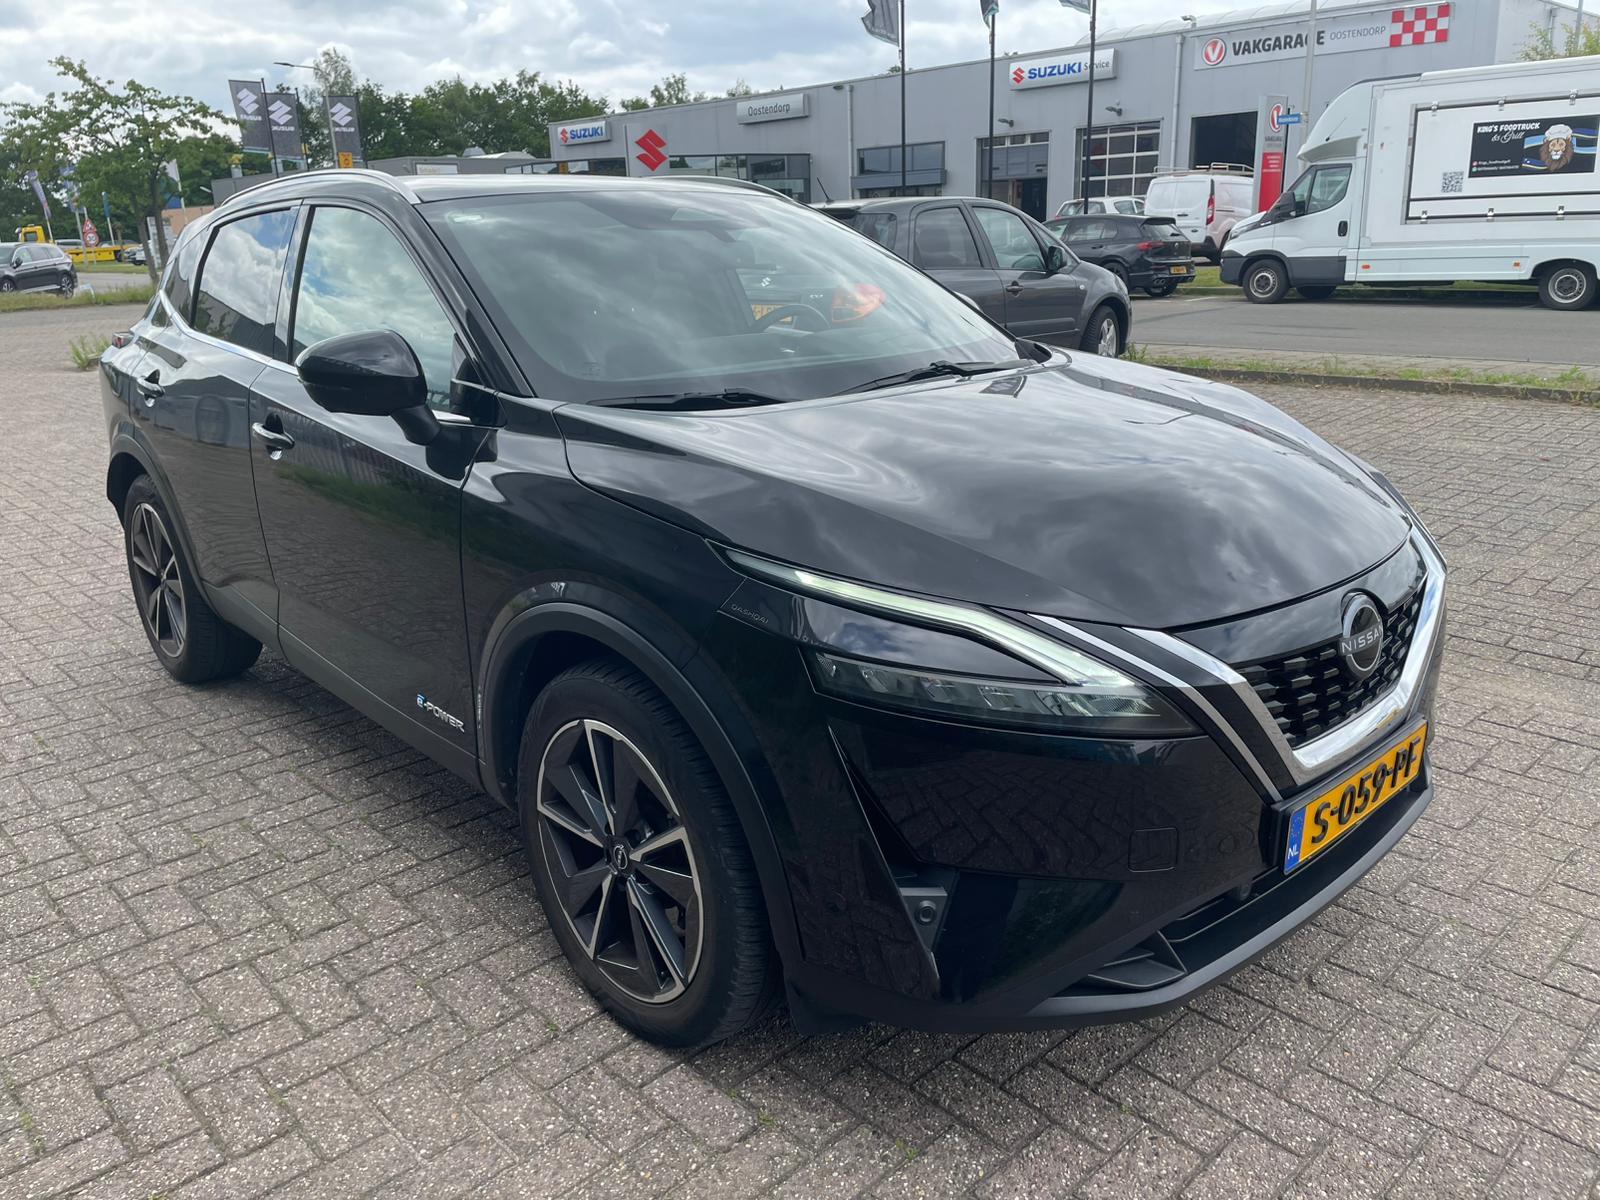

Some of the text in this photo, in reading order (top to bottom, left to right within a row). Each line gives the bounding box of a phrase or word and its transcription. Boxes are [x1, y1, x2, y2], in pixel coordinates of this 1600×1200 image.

[1232, 30, 1325, 57] VAKGARAE
[1329, 25, 1387, 41] OOSTENDORP
[1027, 62, 1082, 80] SUZUKI
[747, 103, 791, 117] Oostendorp
[569, 126, 604, 140] SUZUKI
[1476, 122, 1541, 134] KING'S FOODTRUCK
[1311, 736, 1421, 844] S-059-PF
[1287, 844, 1300, 859] NL
